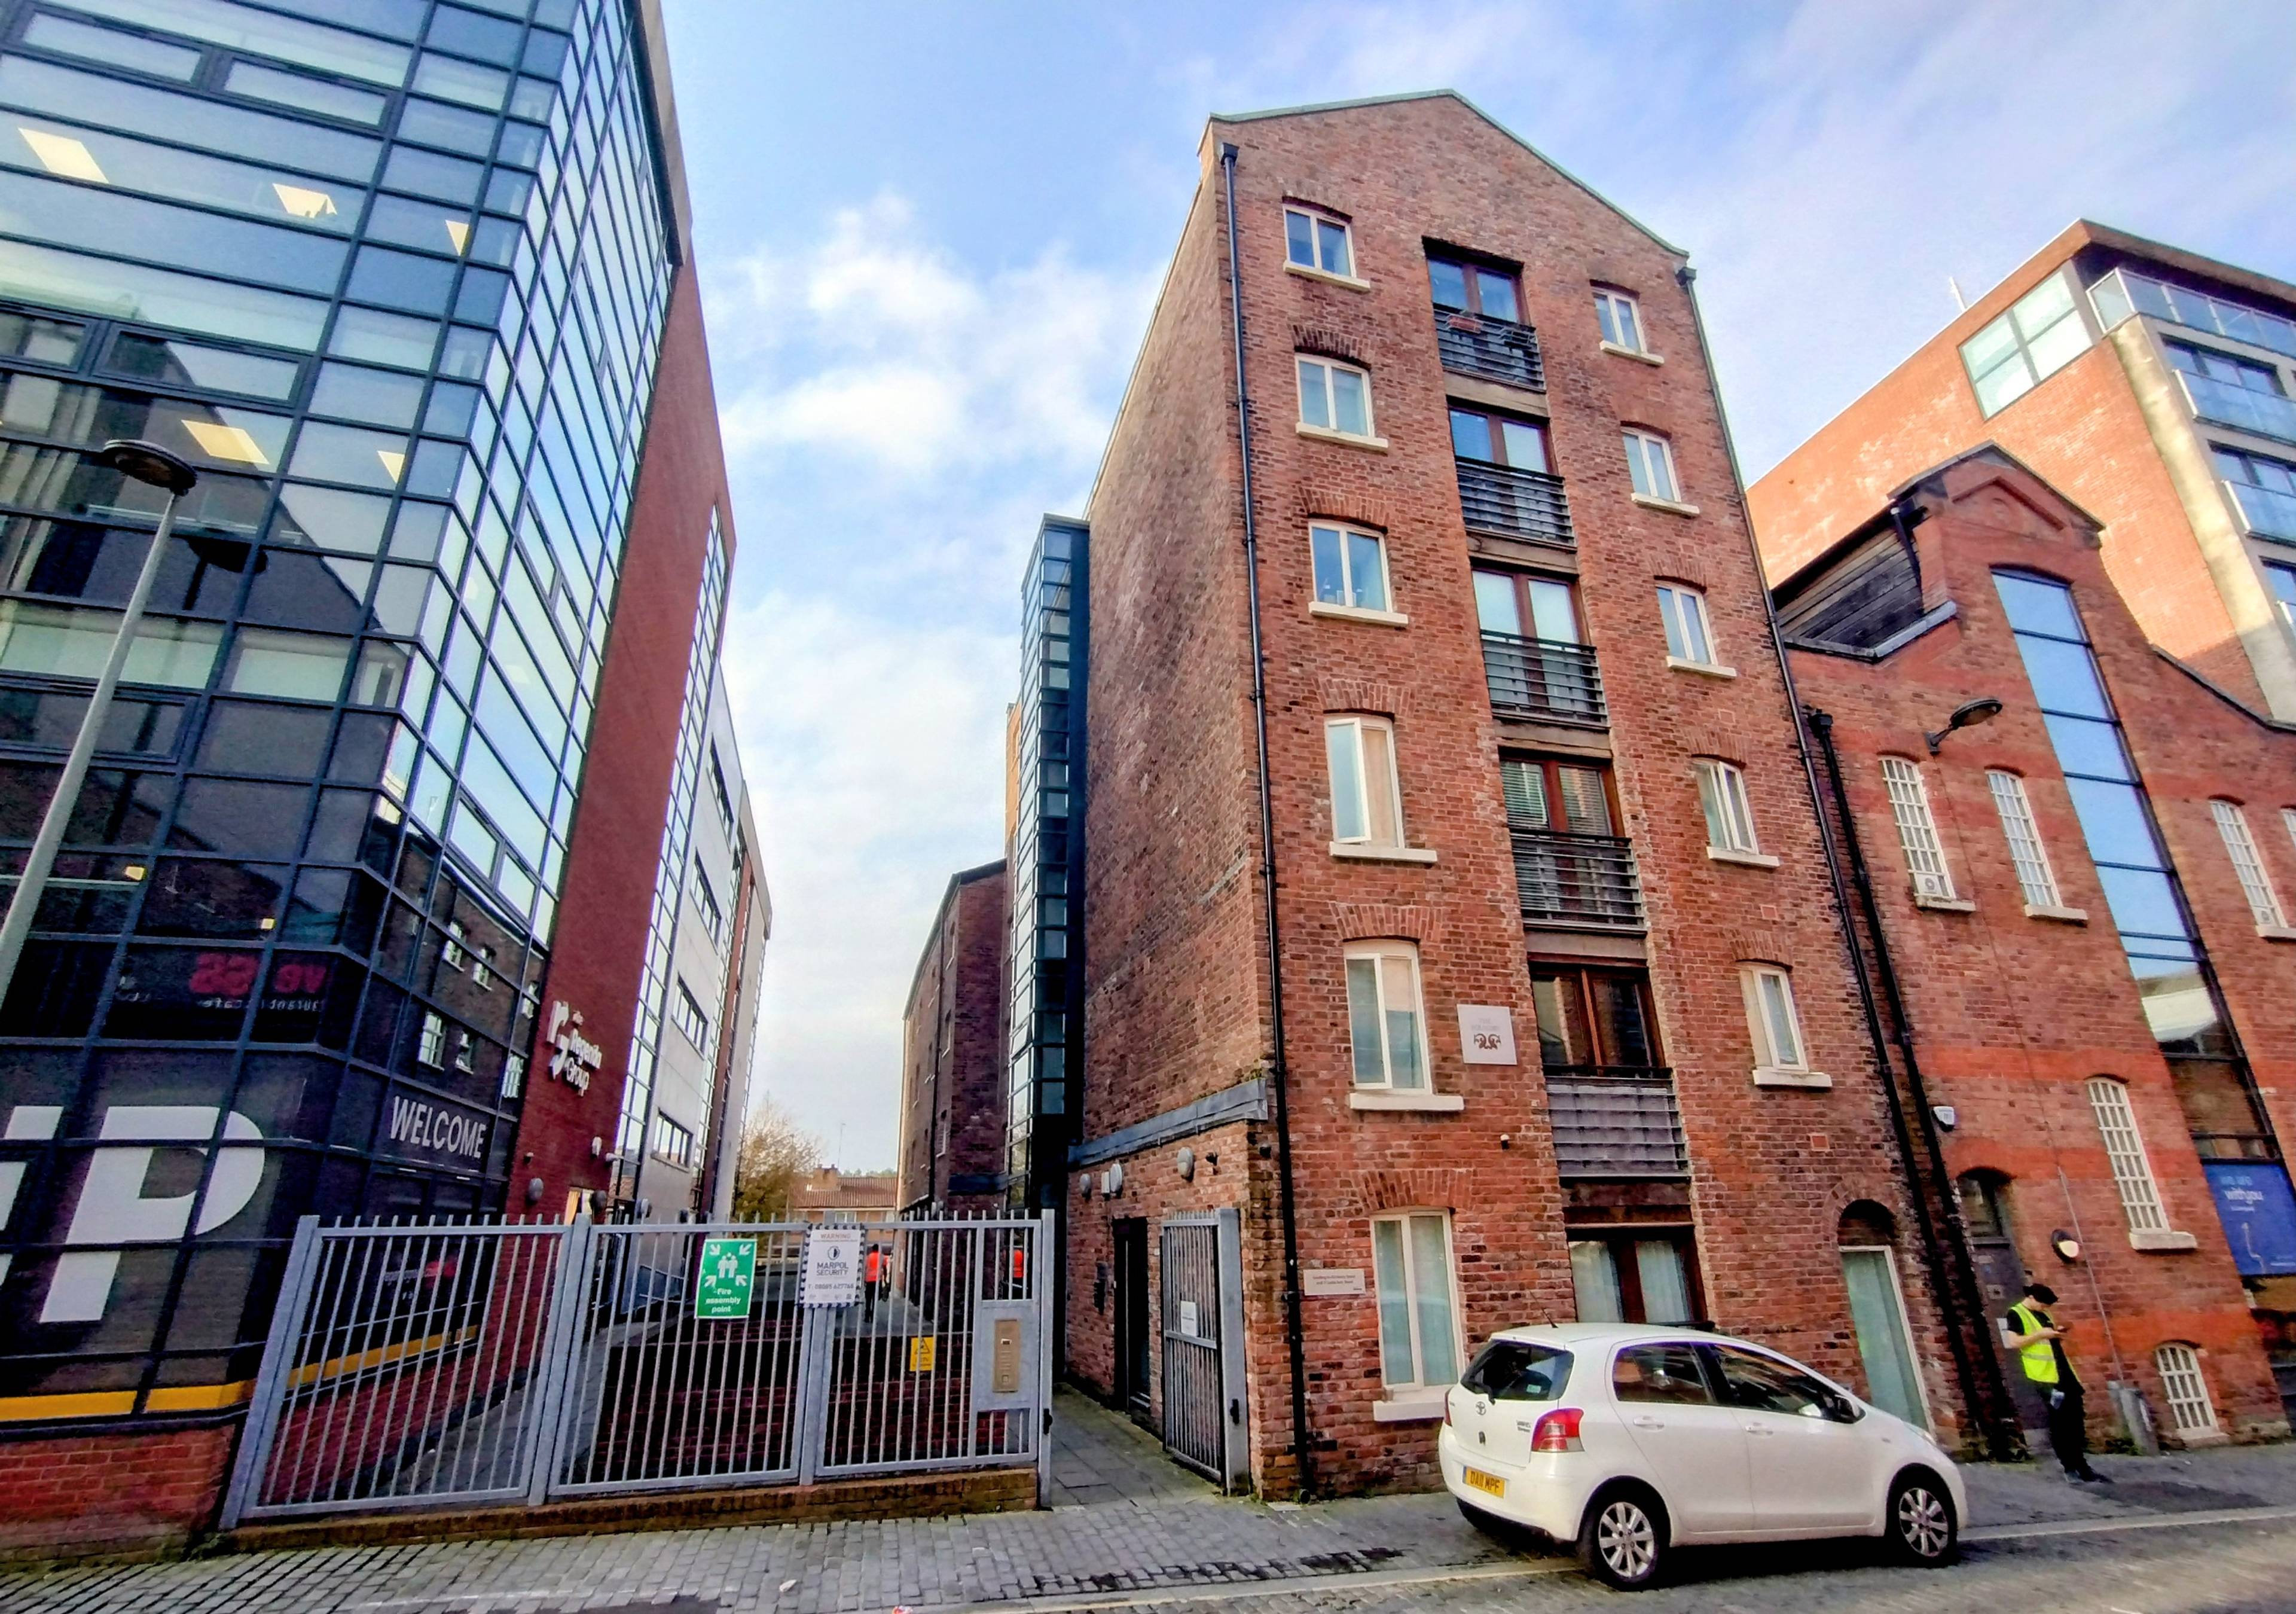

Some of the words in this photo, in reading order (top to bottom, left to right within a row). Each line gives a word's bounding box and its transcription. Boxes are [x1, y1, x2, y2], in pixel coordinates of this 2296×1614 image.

[568, 1028, 602, 1069] Regenda
[564, 1057, 590, 1097] Group
[390, 1096, 487, 1159] WELCOME
